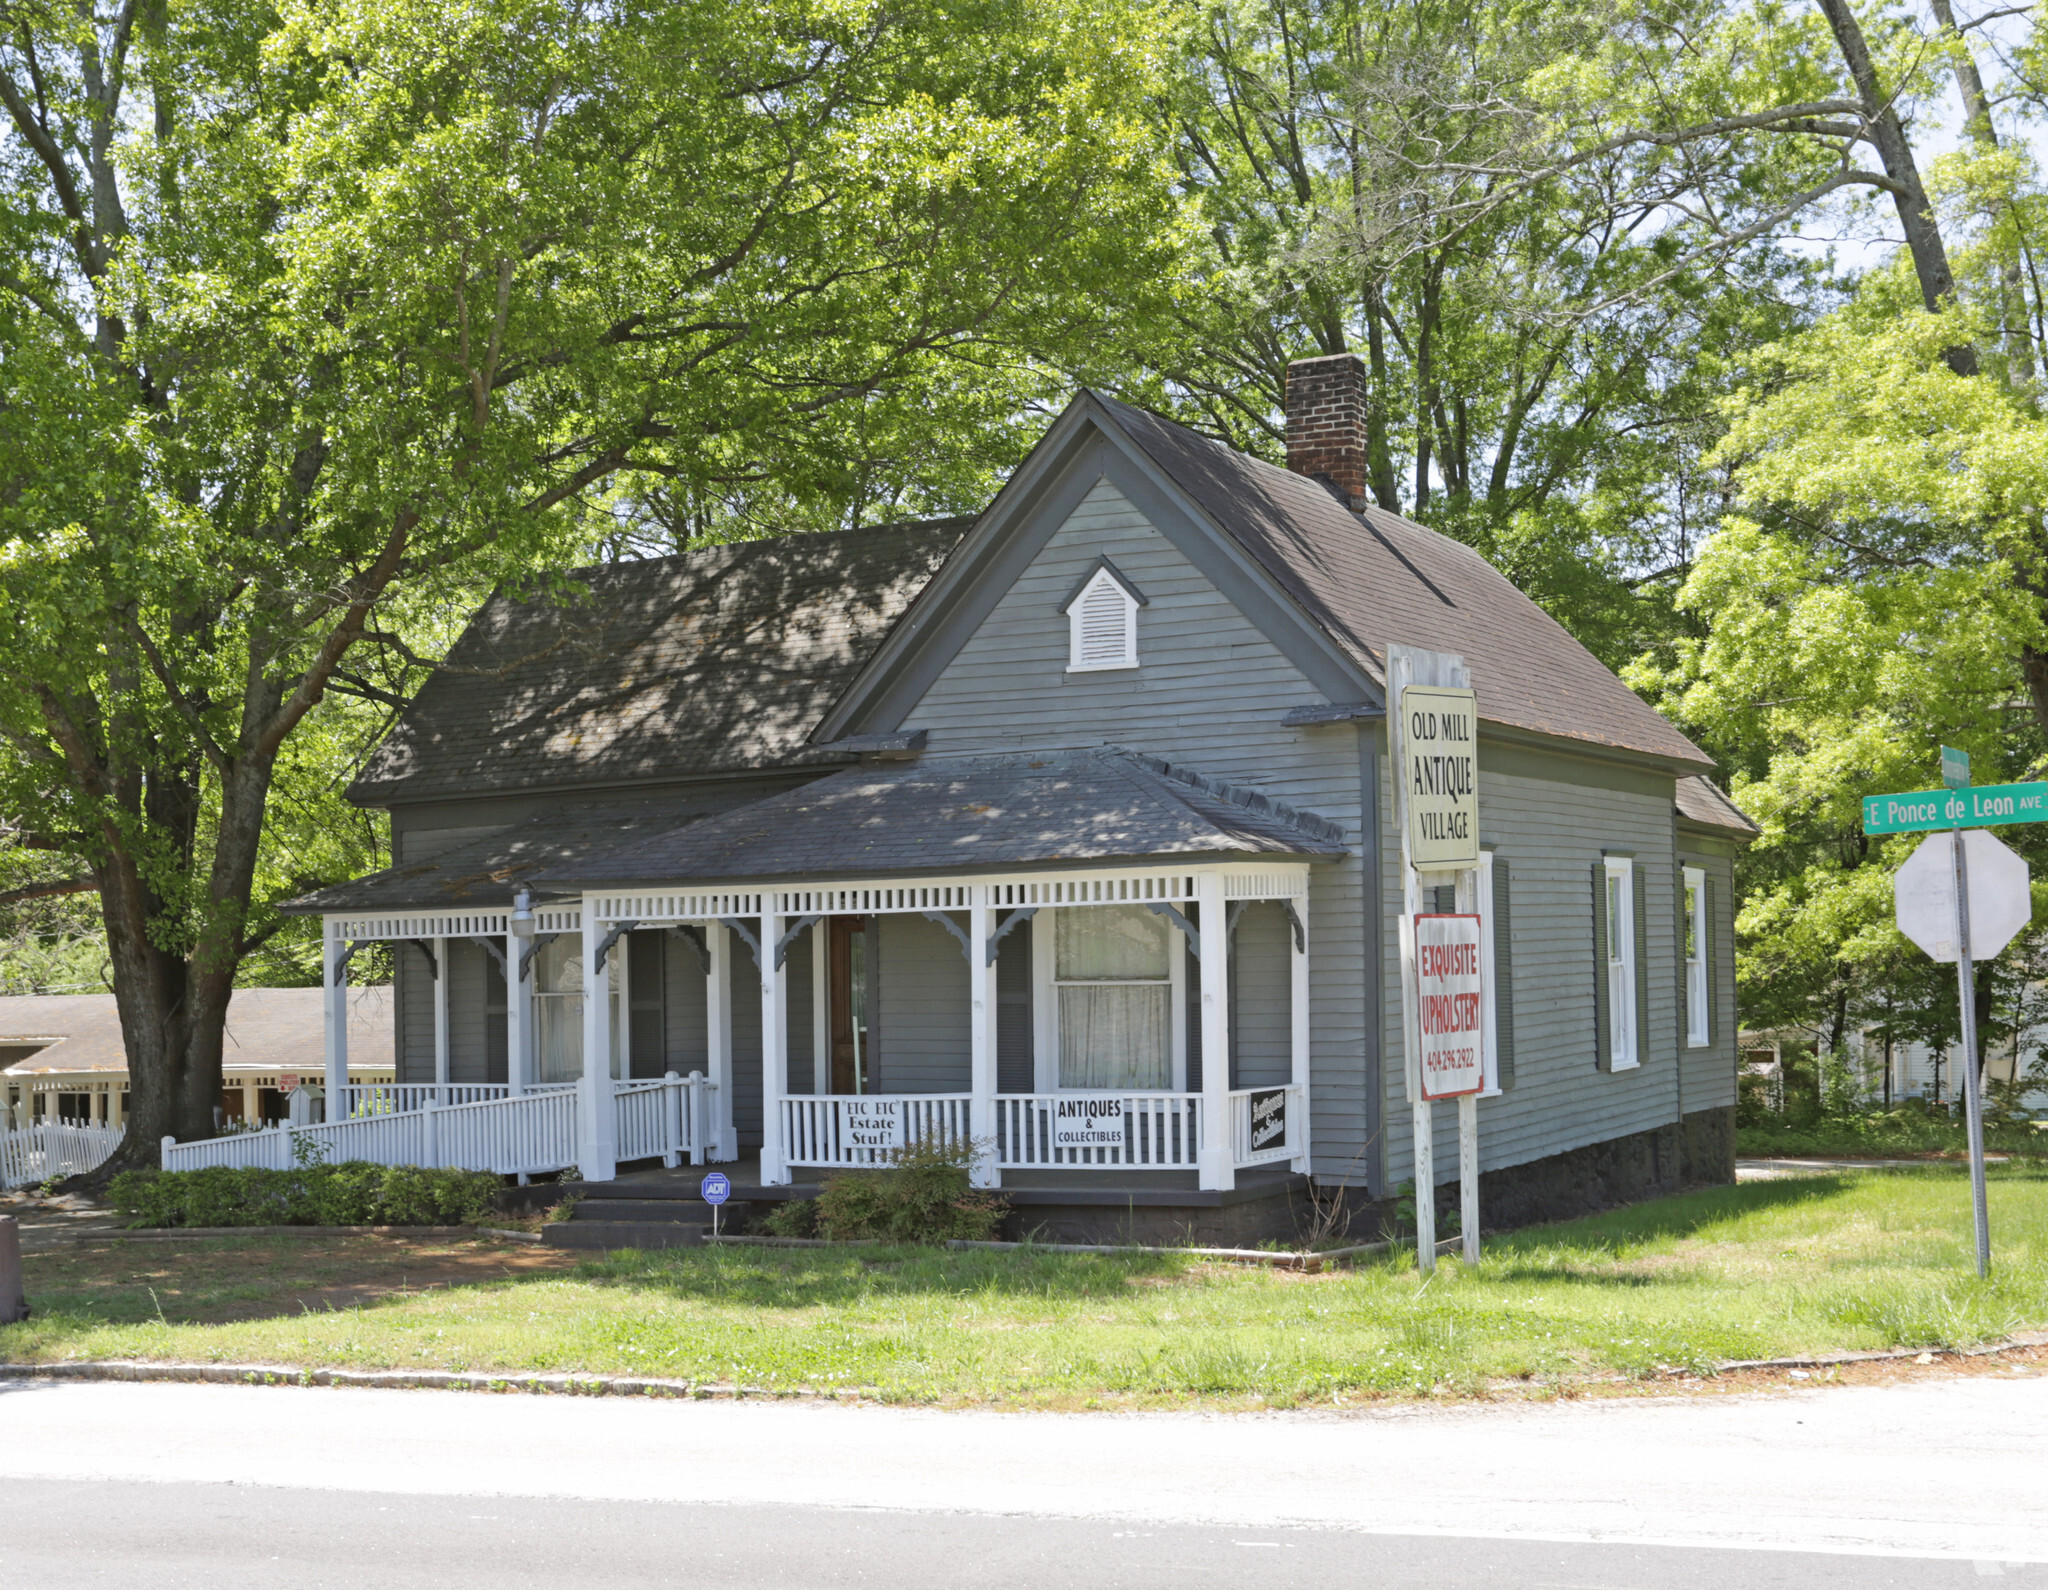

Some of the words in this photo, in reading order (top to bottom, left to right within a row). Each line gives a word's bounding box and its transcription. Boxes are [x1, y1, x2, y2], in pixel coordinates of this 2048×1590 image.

[1412, 711, 1437, 740] OLD
[1442, 713, 1469, 741] MILL
[1414, 755, 1473, 804] ANTIQUE
[1870, 803, 1880, 826] E
[1888, 801, 1937, 825] Ponce
[1945, 797, 1965, 819] de
[1973, 794, 2014, 818] Leon
[2019, 796, 2043, 809] AVE
[1420, 812, 1469, 840] VILLAGE
[1421, 943, 1477, 983] EXQUISITE
[1422, 992, 1480, 1035] UPHOLSTERY
[1427, 1047, 1475, 1073] 404.296.2922
[1058, 1099, 1121, 1118] ANTIQUES
[849, 1116, 895, 1129] Estate
[1085, 1118, 1092, 1129] &
[852, 1131, 892, 1145] Stuf!
[1058, 1131, 1122, 1142] COLLECTIBLES
[706, 1183, 726, 1195] ADT
